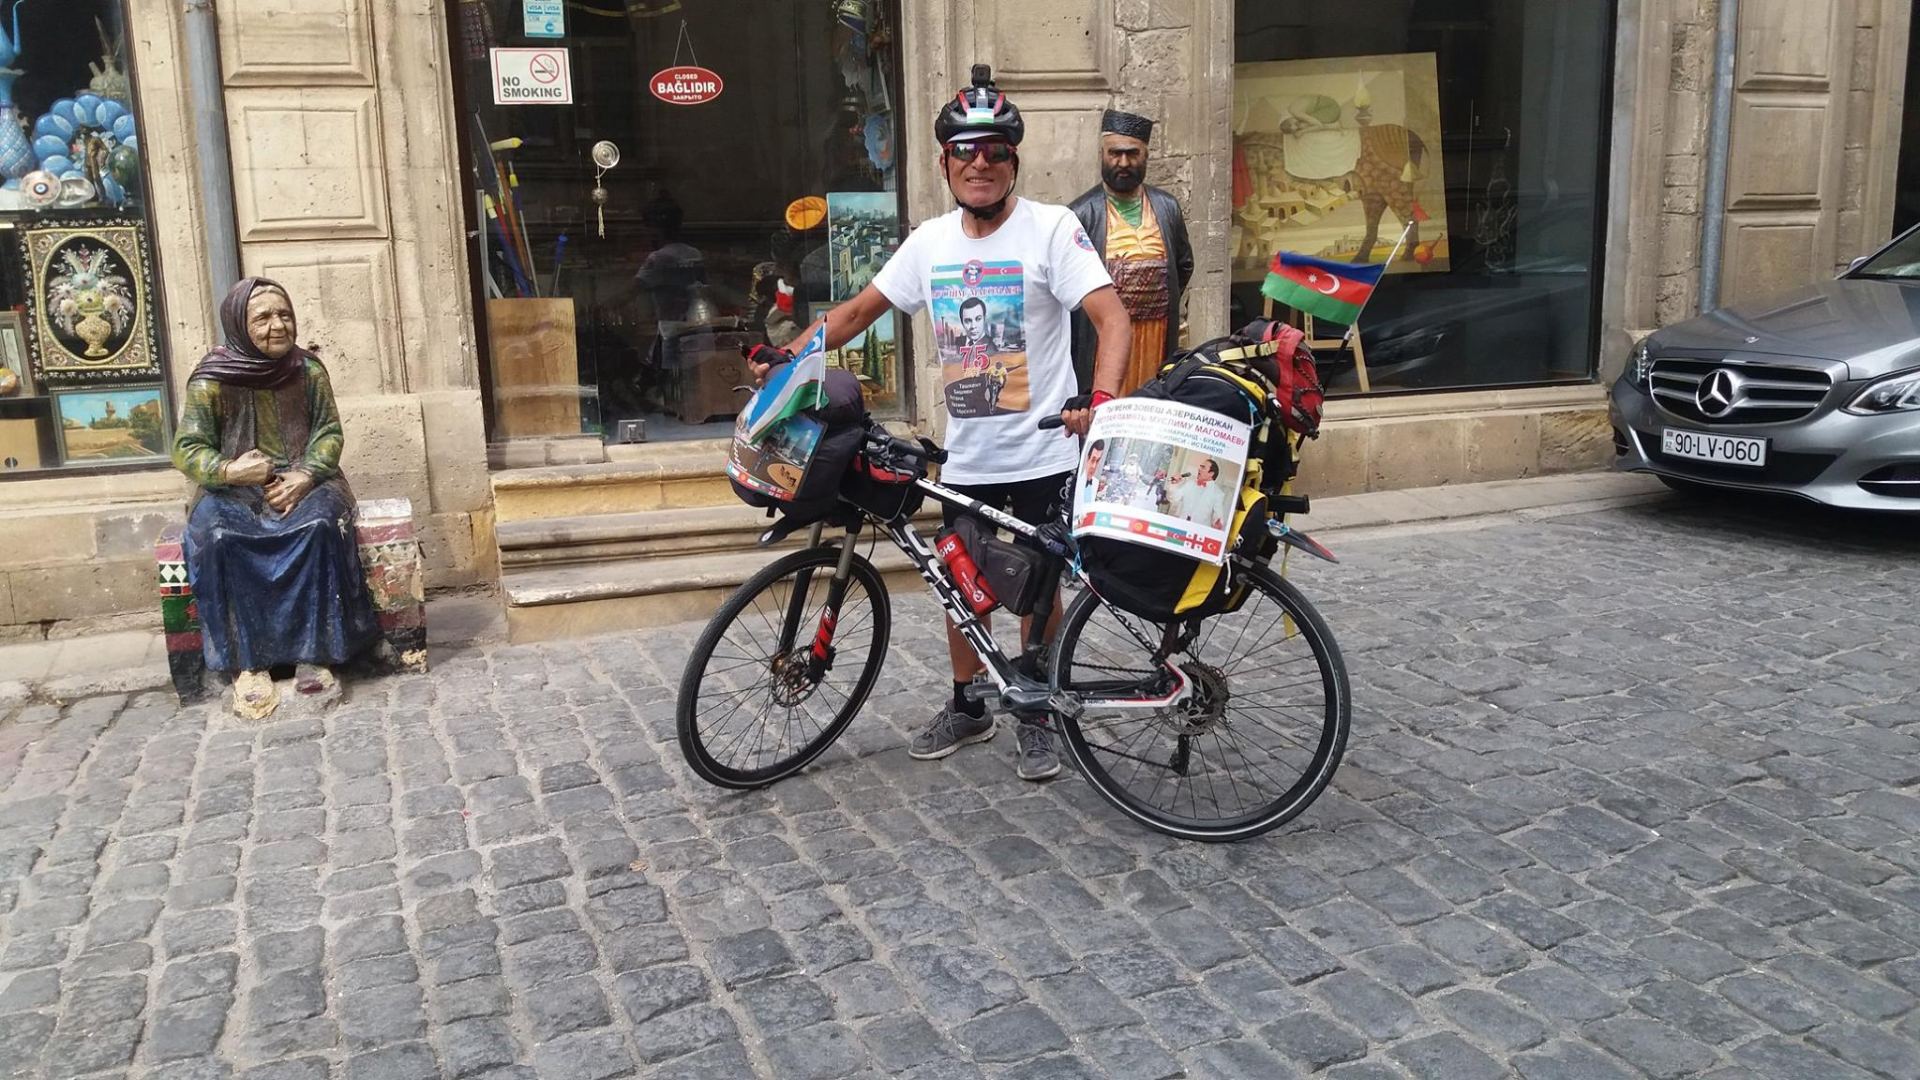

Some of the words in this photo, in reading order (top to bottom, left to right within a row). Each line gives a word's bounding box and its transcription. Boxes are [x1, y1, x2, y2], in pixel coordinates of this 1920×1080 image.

[502, 76, 520, 87] NO
[503, 87, 562, 98] SMOKING
[657, 80, 716, 94] BAĞLIDIR
[959, 344, 991, 371] 75
[1166, 408, 1233, 431] АЗЕРБАЙДЖАН
[1195, 424, 1246, 447] МАГОМАЕВУ
[1675, 433, 1760, 462] 90-LV-060
